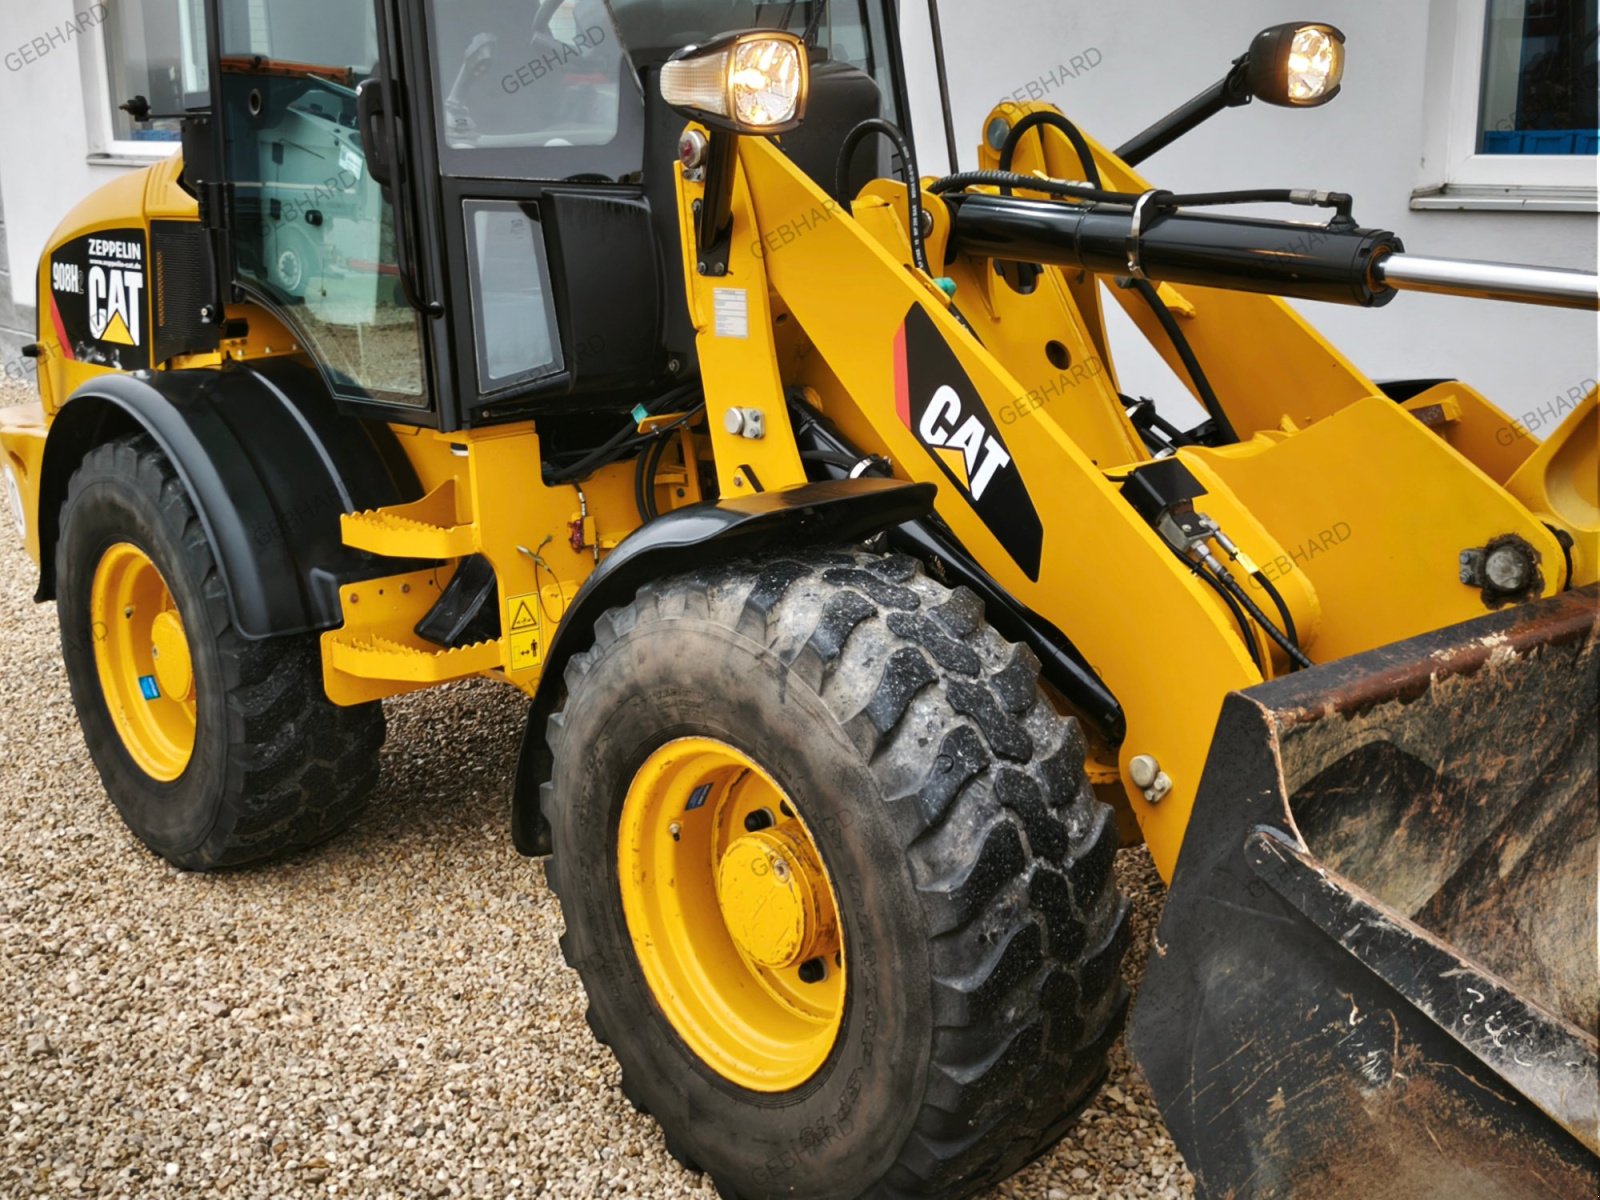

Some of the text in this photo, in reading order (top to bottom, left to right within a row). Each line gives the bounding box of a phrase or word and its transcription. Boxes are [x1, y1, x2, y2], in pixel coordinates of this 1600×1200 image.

[88, 238, 142, 260] ZEPPELIN
[88, 266, 144, 346] CAT
[919, 384, 1011, 502] CAT
